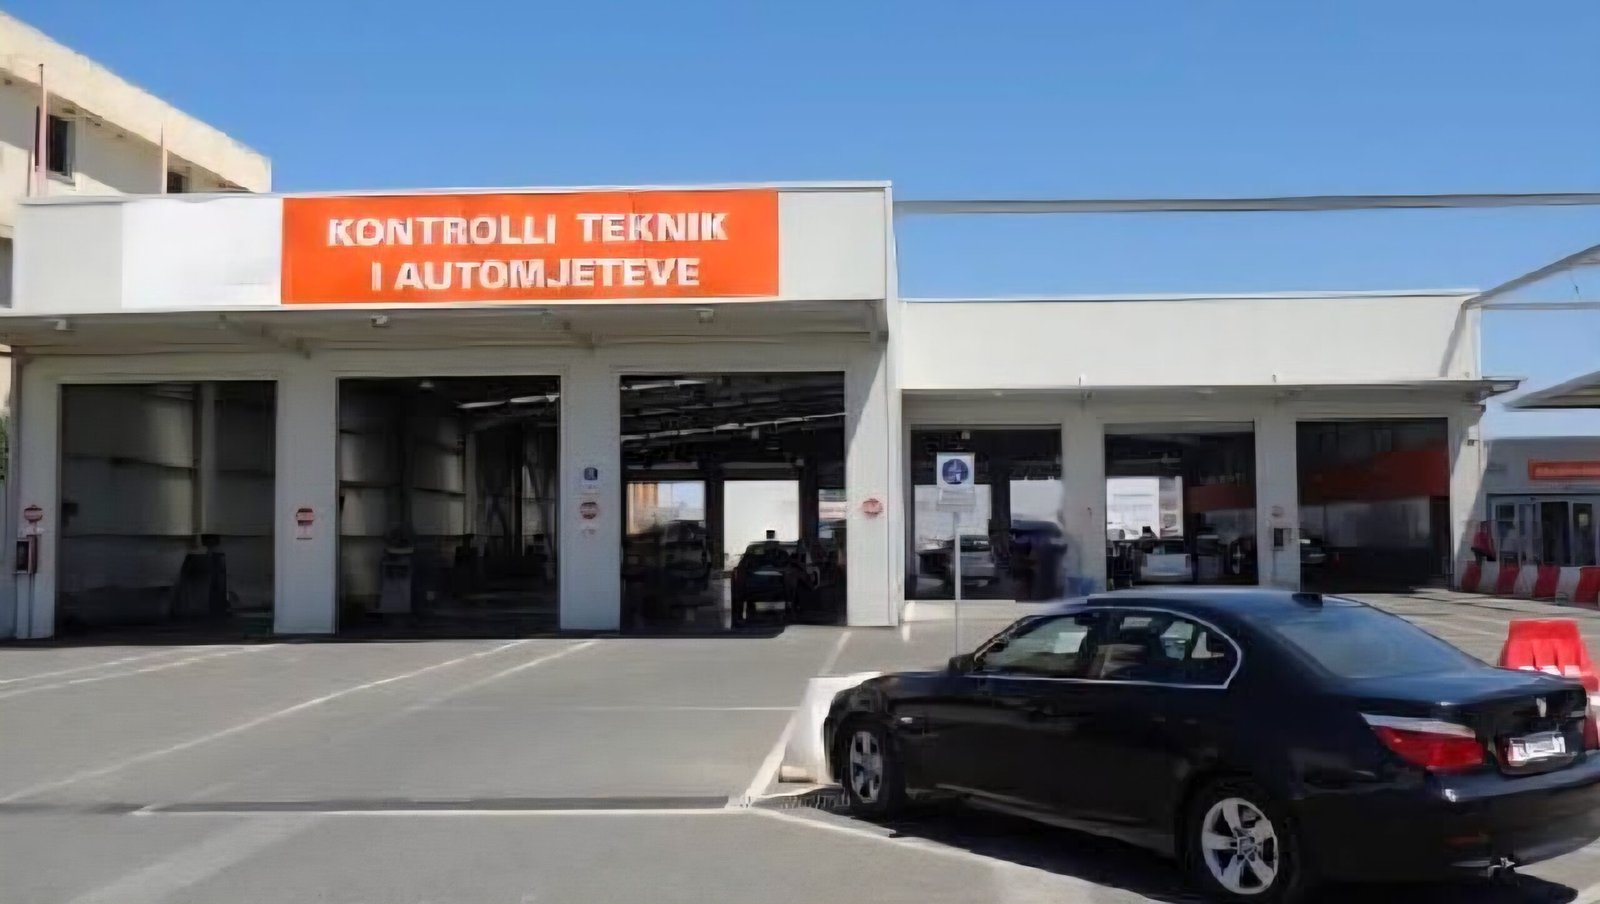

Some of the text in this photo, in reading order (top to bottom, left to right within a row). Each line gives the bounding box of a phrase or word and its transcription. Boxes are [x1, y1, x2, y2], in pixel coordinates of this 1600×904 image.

[328, 212, 729, 247] KONTROLLI TEKNIK
[371, 258, 701, 291] I AUTOMJETEVE
